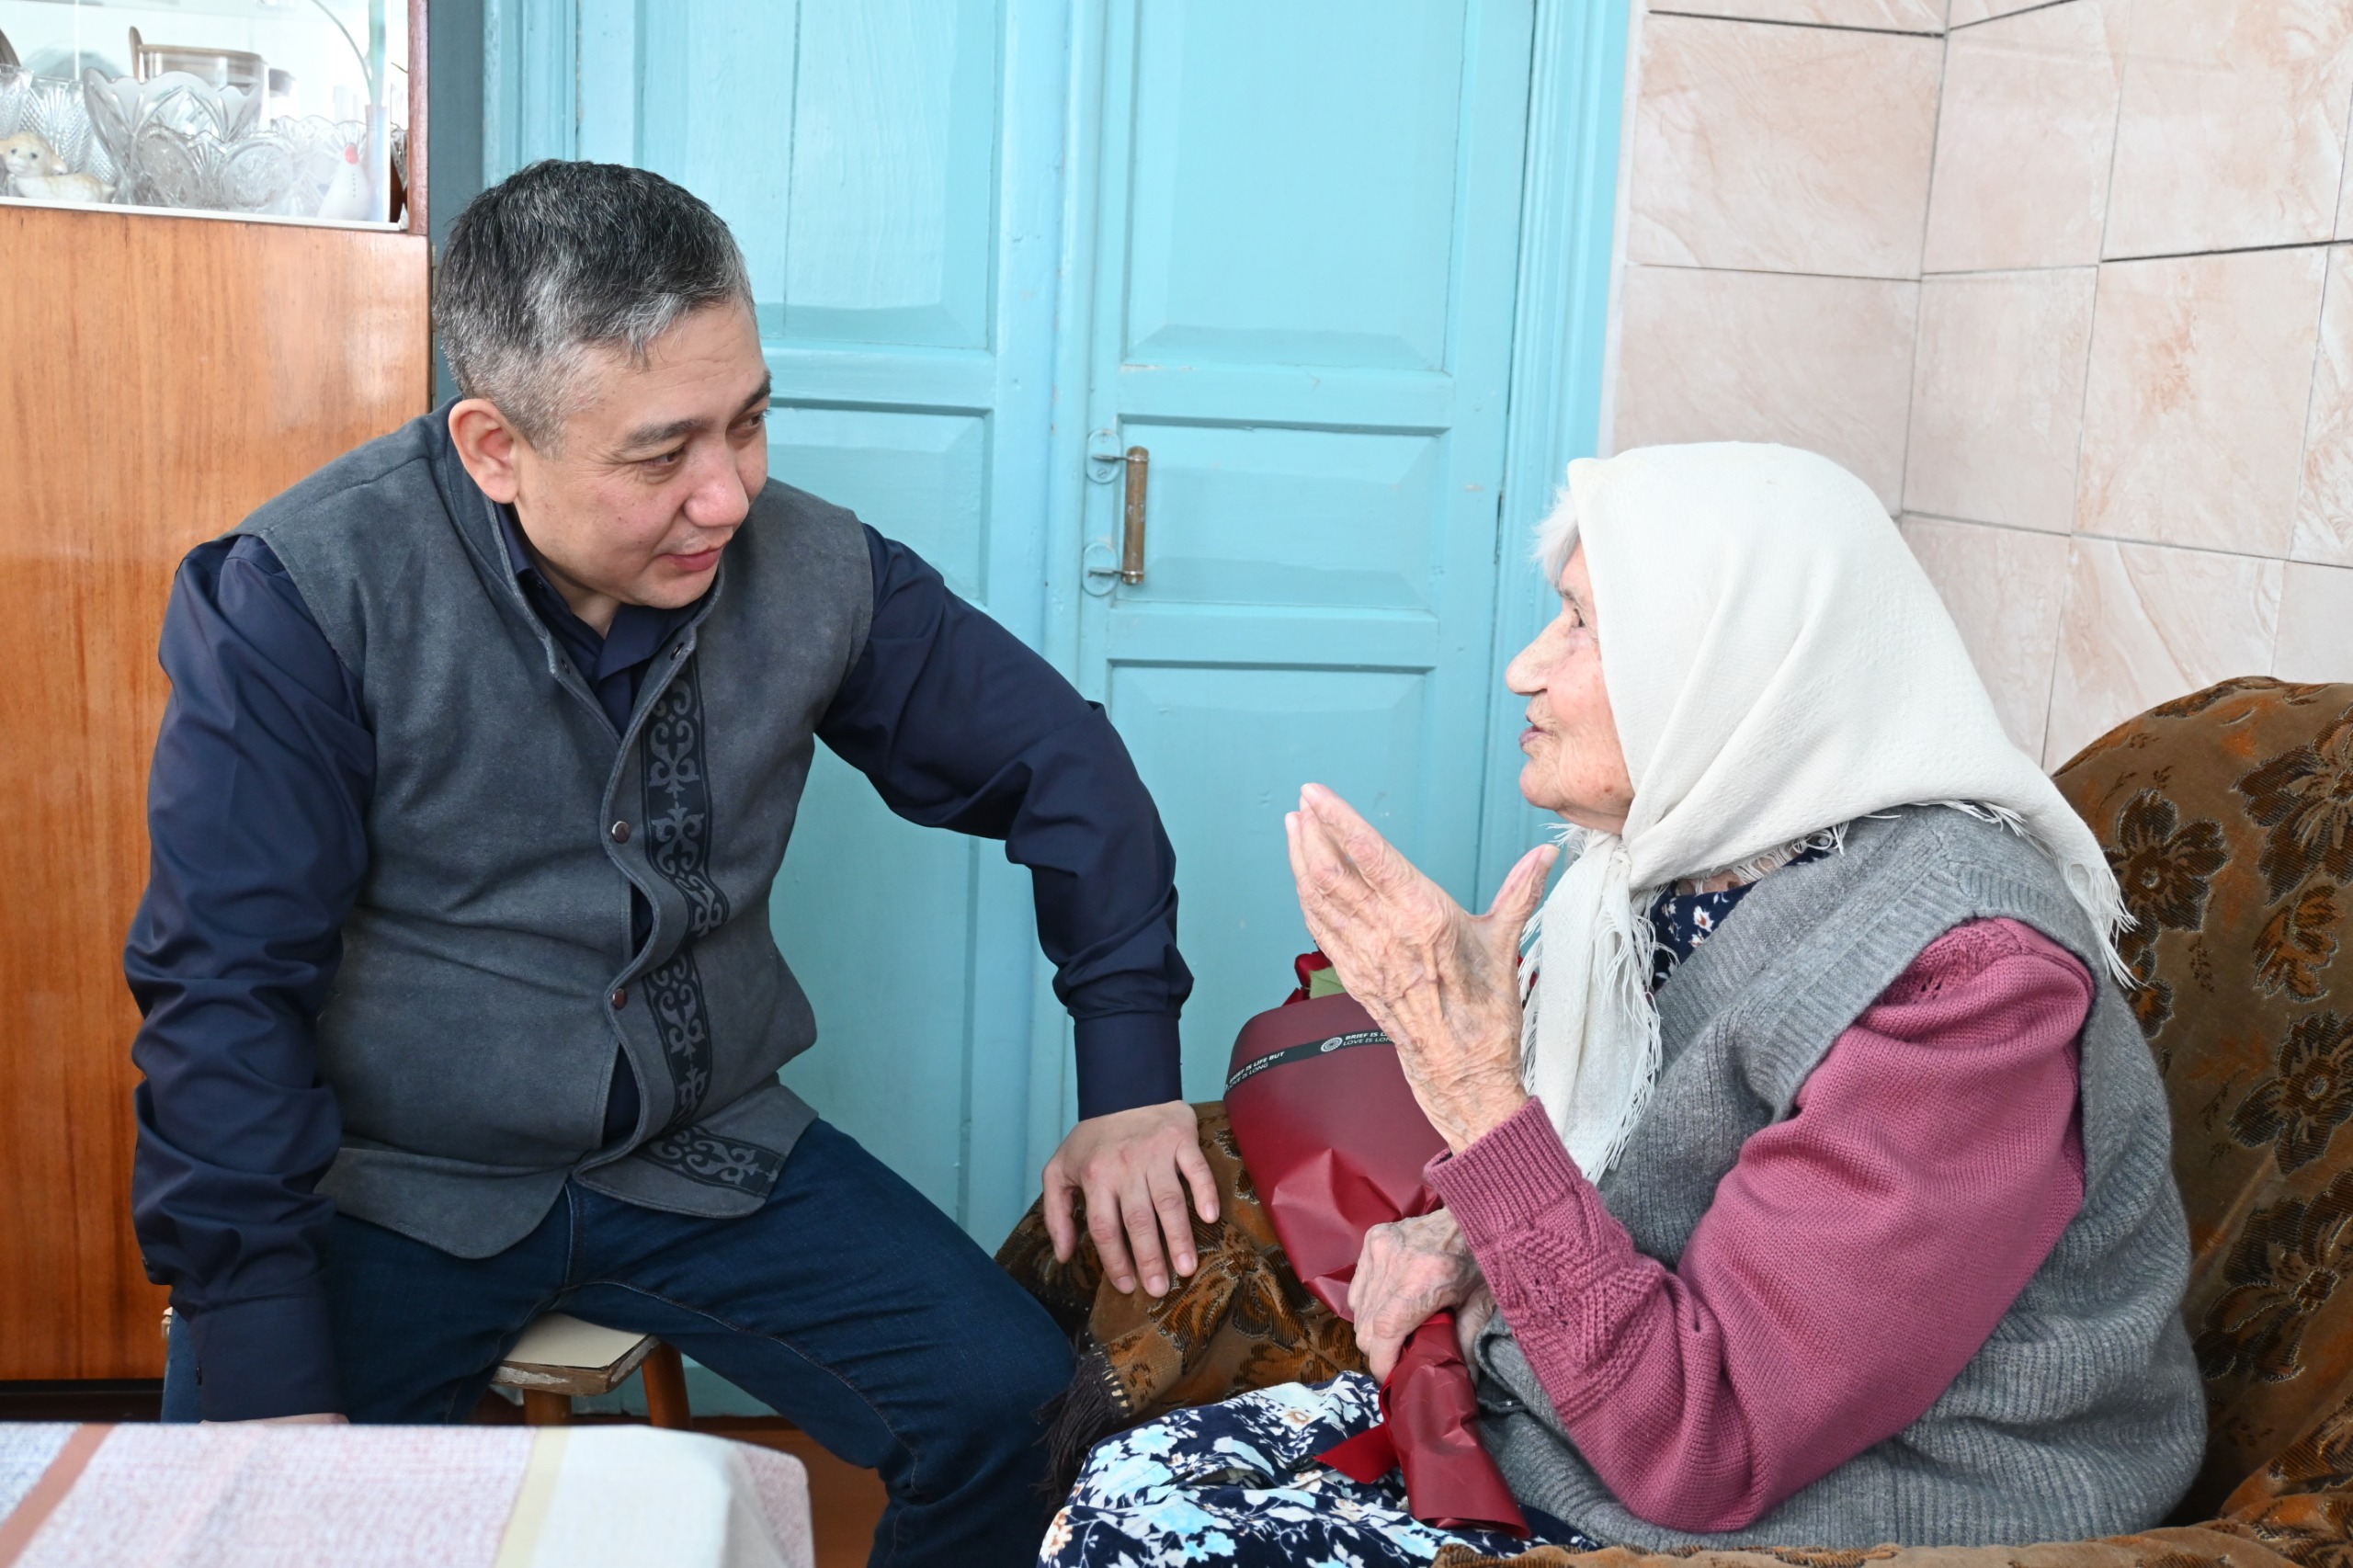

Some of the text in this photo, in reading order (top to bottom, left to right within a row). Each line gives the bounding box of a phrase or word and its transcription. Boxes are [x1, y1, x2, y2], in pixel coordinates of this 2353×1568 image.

[1345, 1032, 1369, 1040] BRIEF
[1253, 1057, 1268, 1067] LIFE
[1268, 1051, 1285, 1061] BUT
[1249, 1062, 1268, 1075] LONG
